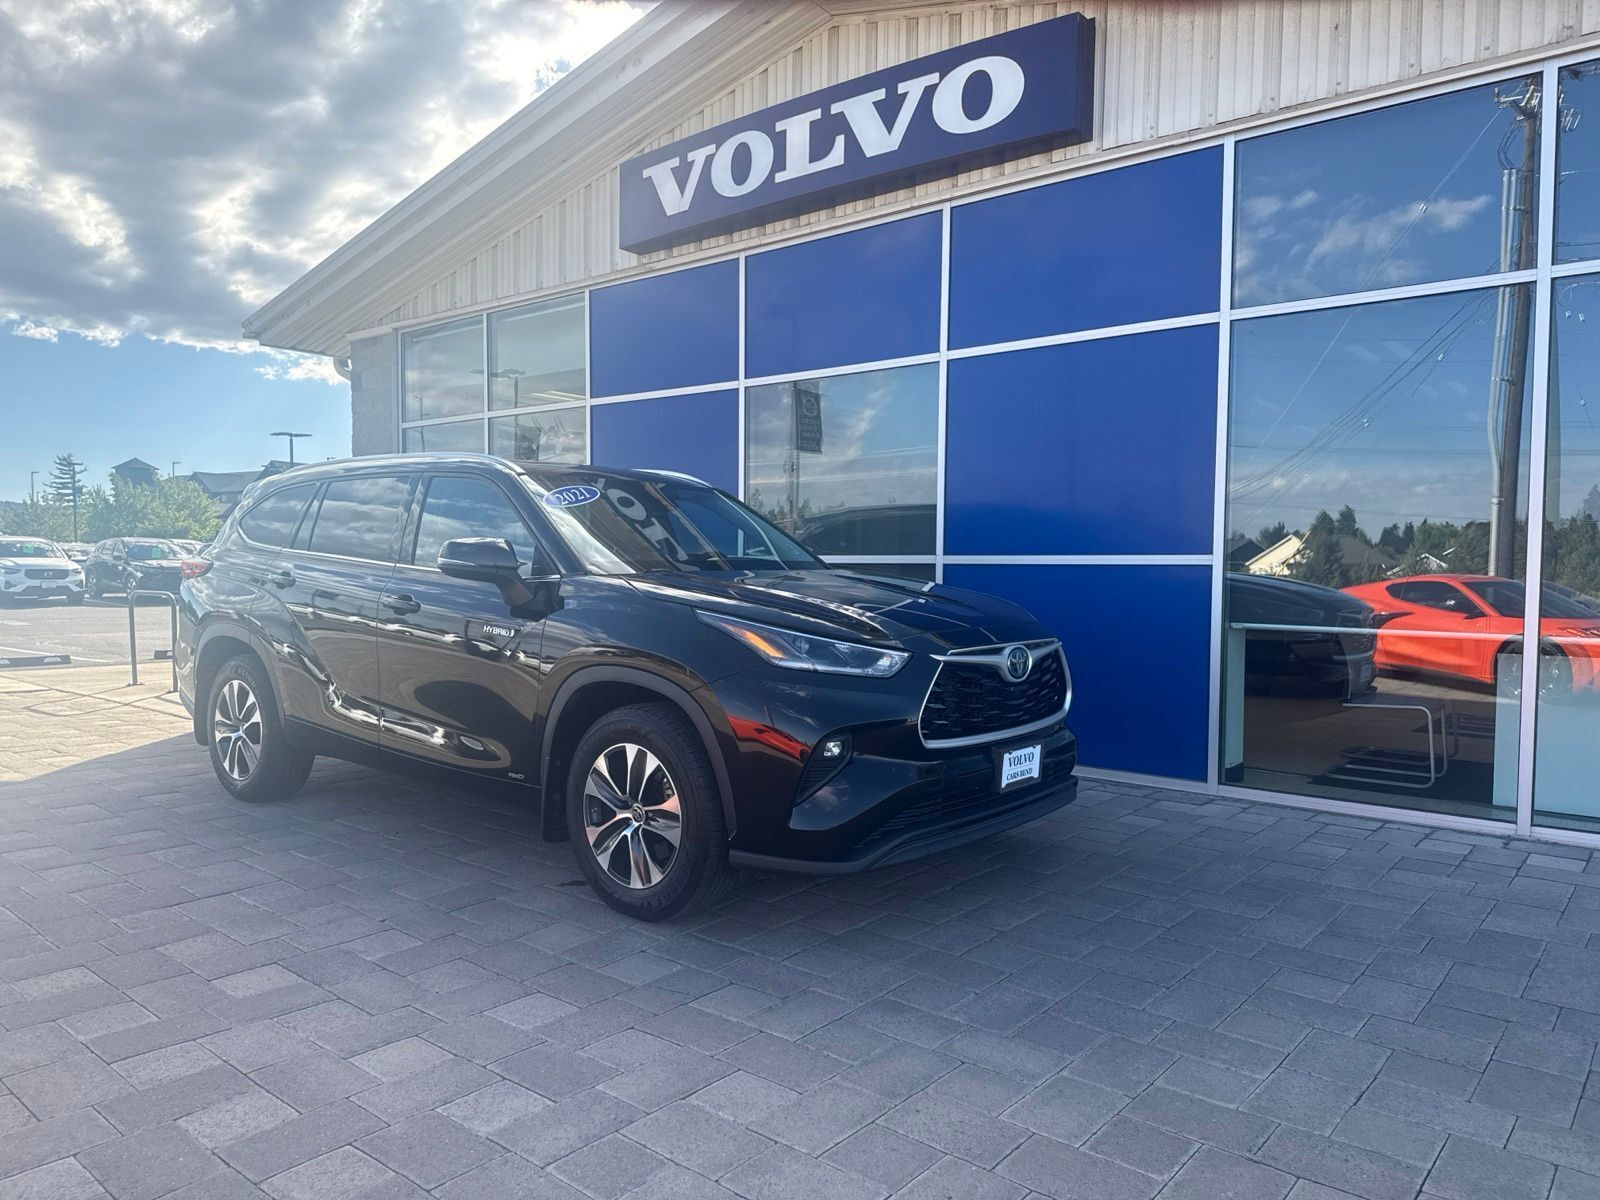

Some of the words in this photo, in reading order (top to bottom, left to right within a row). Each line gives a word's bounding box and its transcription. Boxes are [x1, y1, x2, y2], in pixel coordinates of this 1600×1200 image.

[643, 56, 1025, 217] VOLVO
[554, 487, 591, 505] 2021
[483, 625, 509, 636] HYBRID
[1008, 752, 1034, 768] VOLVO
[1006, 772, 1019, 781] CARS
[1019, 768, 1032, 777] BEND
